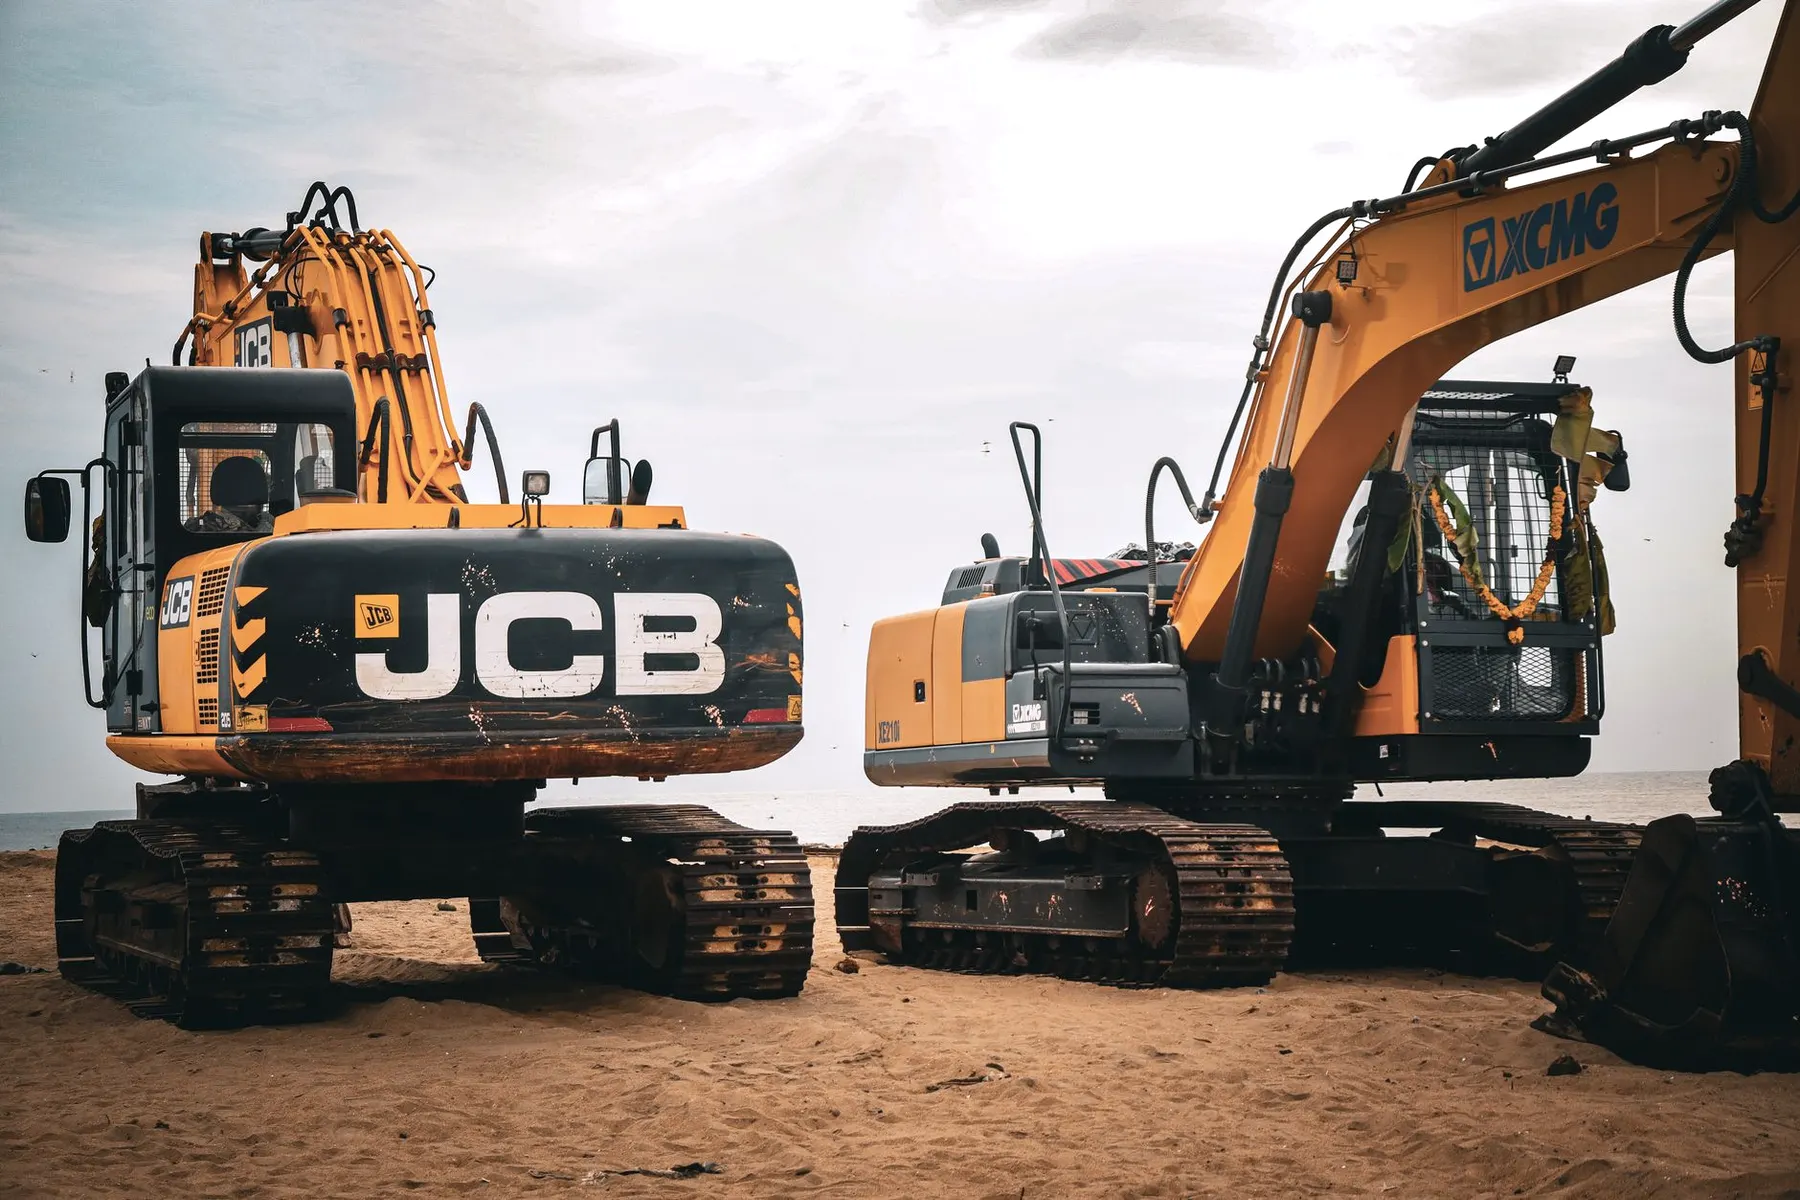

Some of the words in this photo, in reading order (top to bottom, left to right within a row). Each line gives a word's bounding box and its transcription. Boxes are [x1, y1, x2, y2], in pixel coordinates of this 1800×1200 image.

[1496, 182, 1619, 282] XCMG
[235, 323, 272, 367] JCB
[162, 580, 193, 625] JCB
[366, 606, 391, 626] JCB
[355, 591, 726, 700] JCB
[220, 711, 232, 728] 205
[1020, 703, 1042, 722] XCMG
